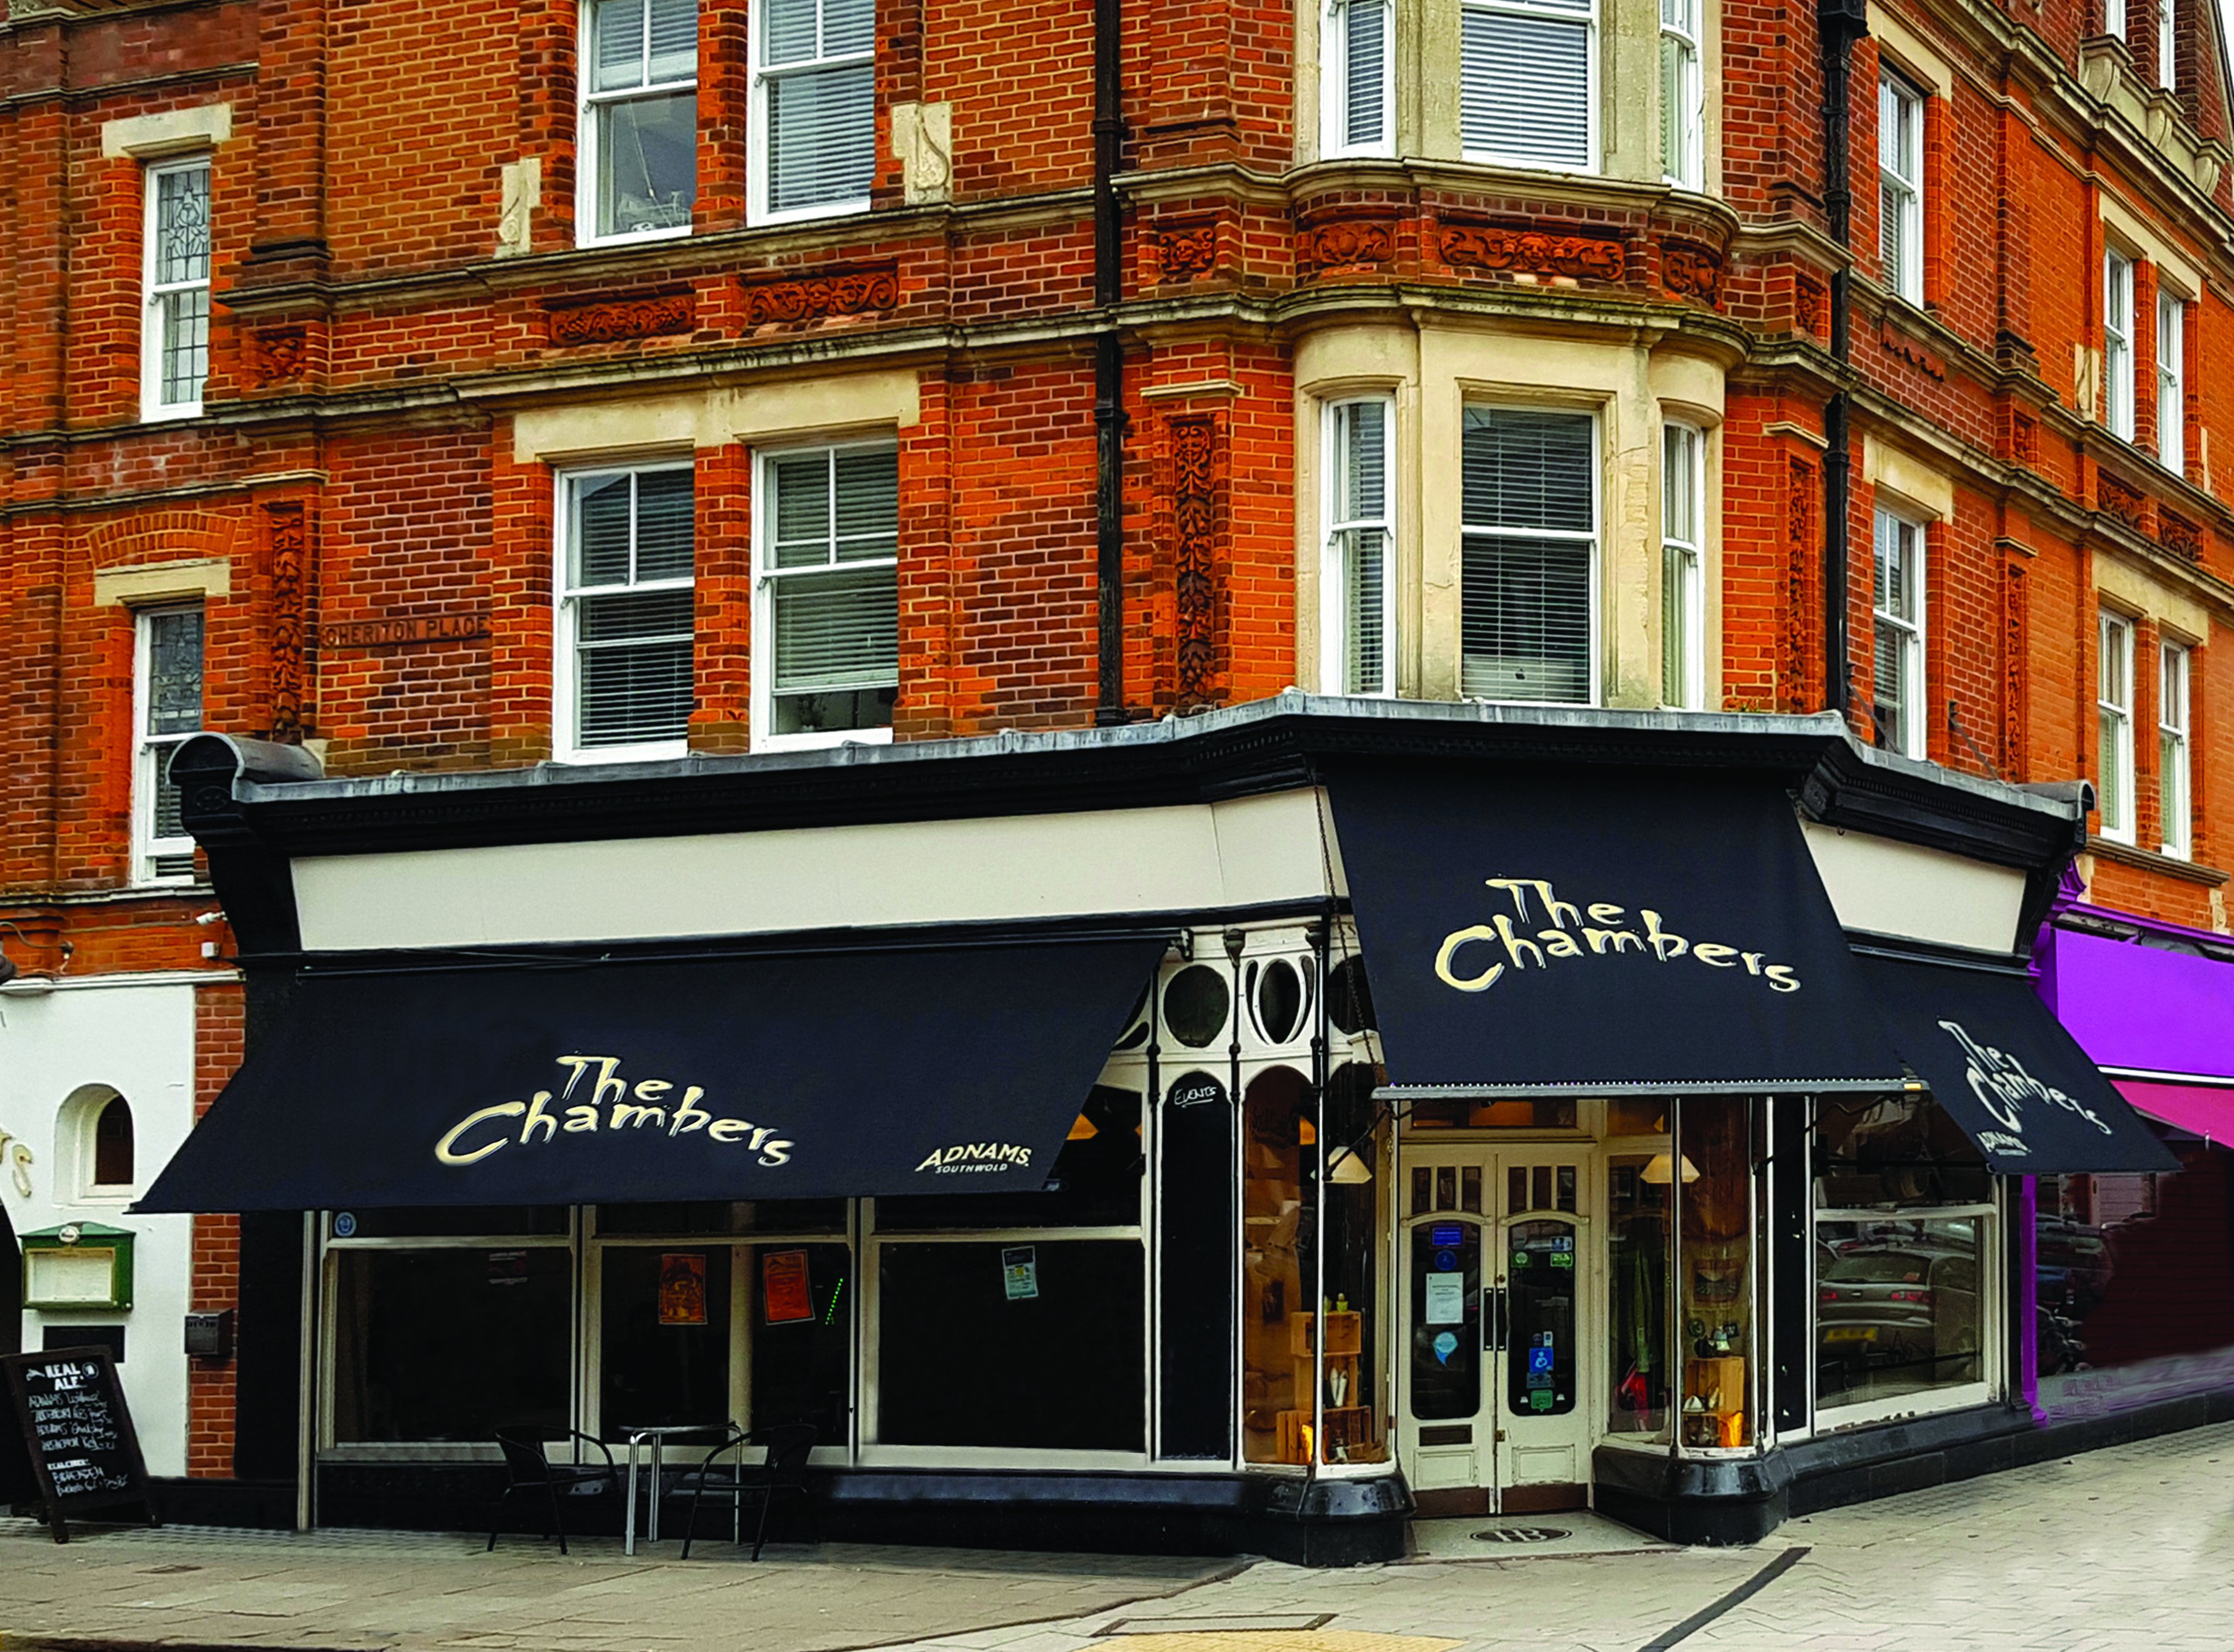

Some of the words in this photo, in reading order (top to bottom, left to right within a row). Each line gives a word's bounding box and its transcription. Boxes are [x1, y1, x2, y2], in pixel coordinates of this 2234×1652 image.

[326, 620, 418, 645] CHERITON
[426, 615, 488, 638] PLACE
[1485, 877, 1625, 929] The
[1435, 909, 1800, 992] Chambers
[1937, 1019, 2010, 1072] The
[555, 1054, 674, 1105] The
[1966, 1053, 2112, 1133] Chambers
[435, 1090, 794, 1166] Chambers
[915, 1142, 1032, 1172] ADNAMS
[934, 1163, 1008, 1174] SOUTHWOLD
